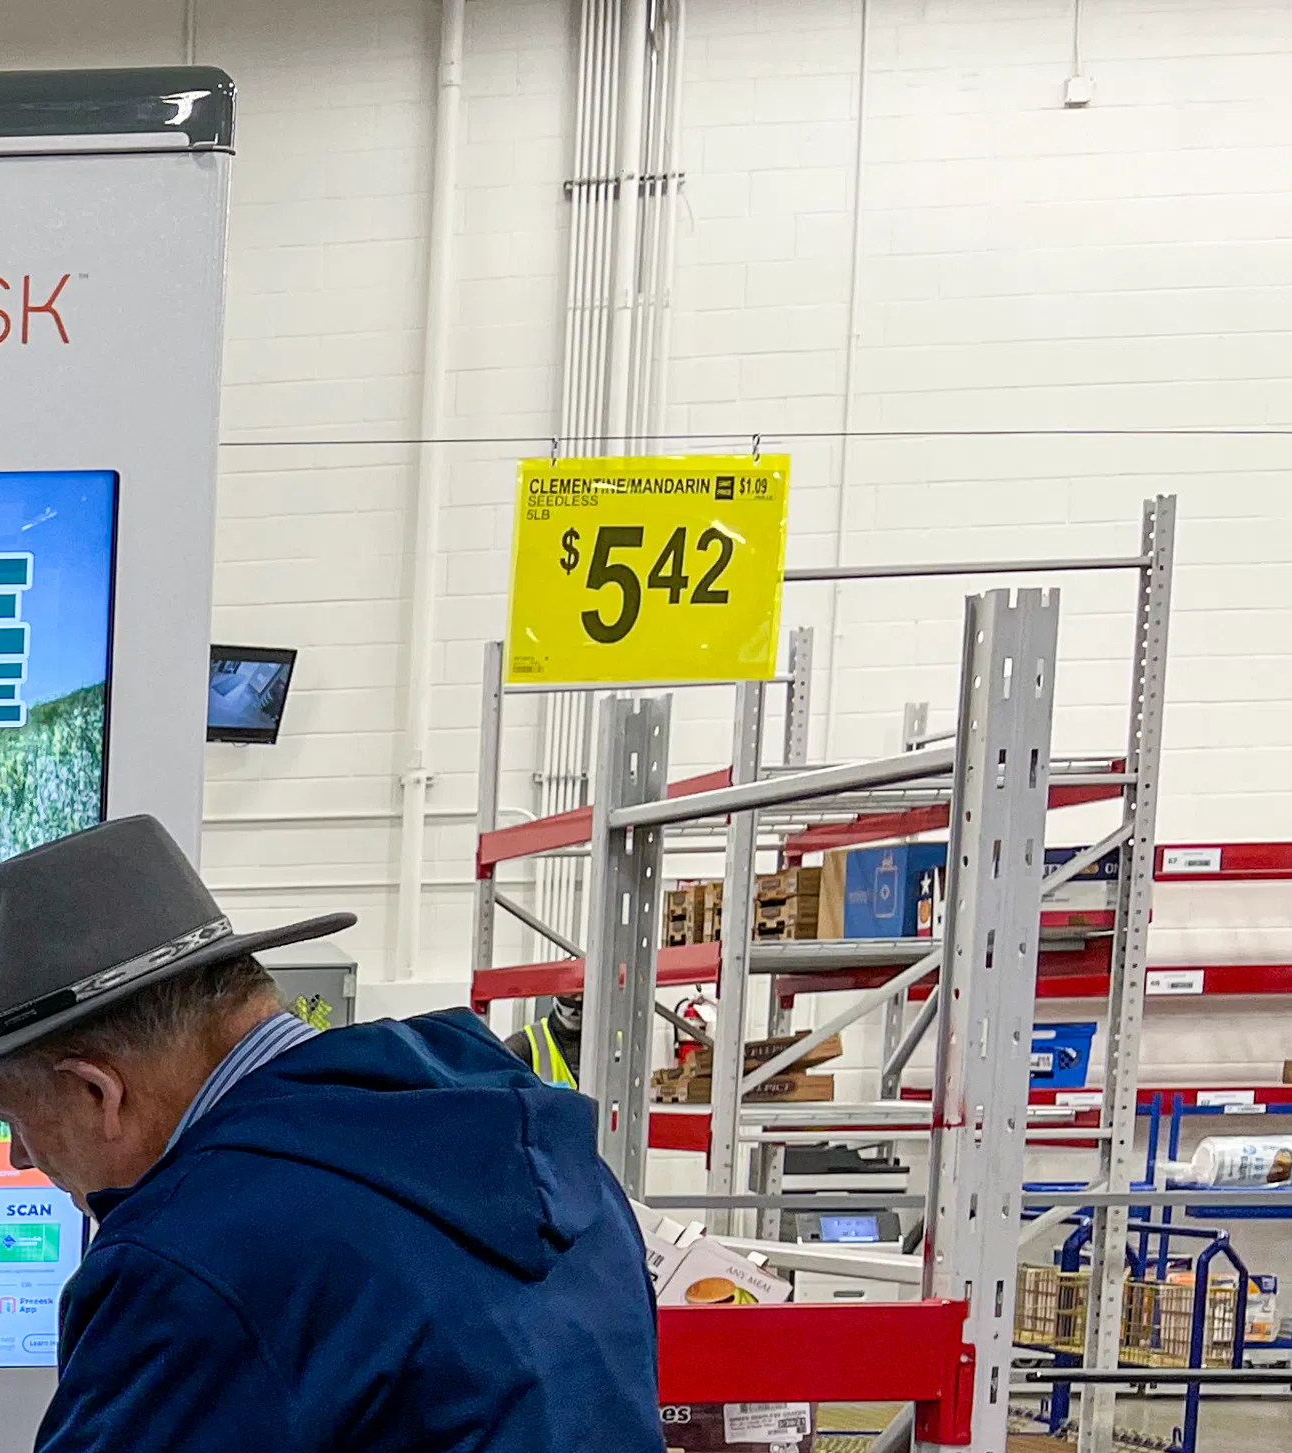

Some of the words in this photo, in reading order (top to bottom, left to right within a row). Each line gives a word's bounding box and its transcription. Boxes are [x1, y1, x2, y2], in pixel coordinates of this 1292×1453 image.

[529, 478, 710, 494] CLEMENTINE/MANDARIN
[527, 495, 599, 507] SEEDLESS
[526, 509, 551, 521] 5LB
[6, 1203, 52, 1217] SCAN
